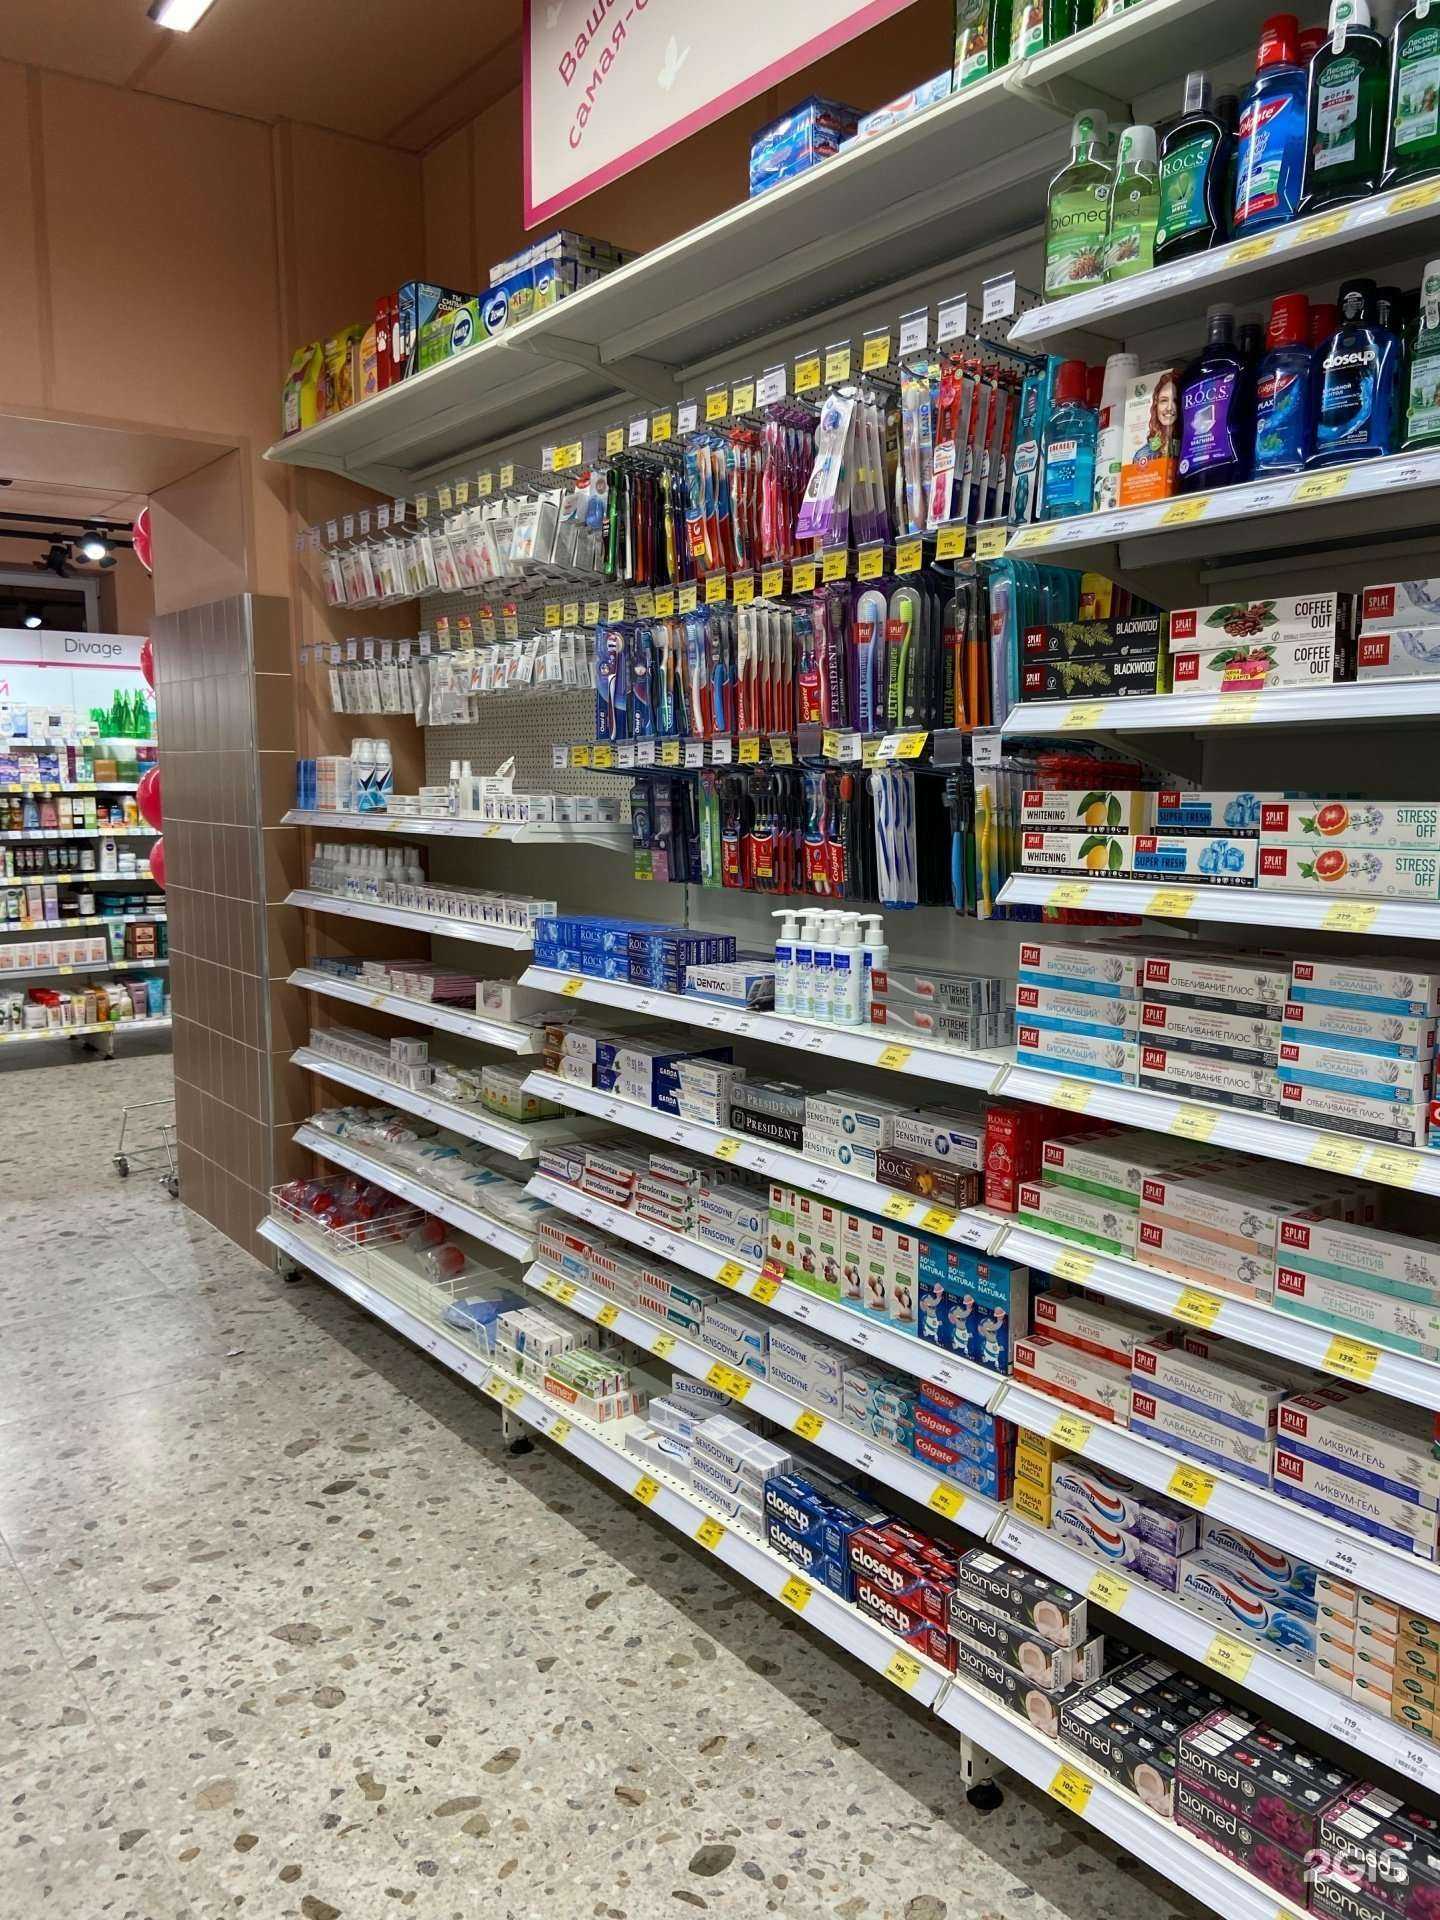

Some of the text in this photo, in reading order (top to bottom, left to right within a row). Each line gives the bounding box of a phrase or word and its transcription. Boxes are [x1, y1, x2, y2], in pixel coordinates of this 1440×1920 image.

[559, 0, 616, 87] Ваш
[1322, 350, 1376, 370] closeup
[1295, 600, 1333, 616] COFFEE
[1116, 620, 1158, 635] BLACKWOOD
[1311, 615, 1332, 629] OUT
[64, 638, 122, 658] Divage
[1294, 645, 1331, 661] COFFEE
[1114, 661, 1156, 676] BLACKWOOD
[1309, 660, 1330, 675] OUT
[829, 644, 839, 714] PRESIDENT
[887, 682, 899, 719] ULTRA
[944, 688, 953, 725] ULTRA
[1026, 810, 1066, 820] WHITENING
[1159, 811, 1212, 822] SUPER FRESH
[1396, 809, 1438, 824] STRESS
[1416, 823, 1437, 838] OFF
[1027, 852, 1067, 863] WHITENING
[1135, 855, 1186, 868] SUPER FRESH
[1395, 857, 1436, 873] STRESS
[1414, 872, 1436, 887] OFF
[1023, 947, 1040, 963] SPLAT
[1147, 964, 1168, 979] SPLAT
[939, 984, 969, 997] EXTREME
[1171, 976, 1254, 997] ОТБЕЛИВАНИЕ ПЛЮС
[948, 995, 969, 1008] WHITE
[1020, 990, 1038, 1006] SPLAT
[938, 1017, 969, 1032] EXTREME
[1144, 1008, 1164, 1024] SPLAT
[948, 1029, 969, 1043] WHITE
[1021, 1030, 1038, 1046] SPLAT
[1167, 1022, 1250, 1044] ОТБЕЛИВАНИЕ ПЛЮС
[1144, 1051, 1164, 1068] SPLAT
[1167, 1066, 1250, 1090] ОТБЕЛИВАНИЕ ПЛЮС
[1306, 1097, 1385, 1121] ОТБЕЛИВАНИЕ ПЛЮС
[746, 1115, 799, 1142] PRESIDENT
[806, 1112, 840, 1127] SENSITIVE
[803, 1140, 836, 1157] SENSITIVE
[896, 1129, 933, 1148] SENSITIVE
[539, 1155, 567, 1170] parodontax
[590, 1159, 618, 1176] parodontax
[650, 1159, 679, 1175] parodontax
[586, 1178, 615, 1196] parodontax
[638, 1182, 670, 1200] parodontax
[1145, 1184, 1163, 1199] SPLAT
[638, 1200, 670, 1220] parodontax
[701, 1199, 733, 1220] SENSODYNE
[540, 1223, 566, 1243] LACALUT
[701, 1226, 736, 1246] SENSODYNE
[1142, 1227, 1161, 1242] SPLAT
[1285, 1227, 1307, 1242] SPLAT
[539, 1243, 562, 1264] LACALUT
[591, 1253, 617, 1273] LACALUT
[1327, 1248, 1384, 1270] СЕНСИТИВ
[920, 1262, 946, 1279] NATURAL
[1281, 1273, 1302, 1288] SPLAT
[591, 1271, 616, 1292] LACALUT
[643, 1270, 671, 1293] LACALUT
[948, 1273, 976, 1290] NATURAL
[977, 1285, 1008, 1302] NATURAL
[639, 1294, 667, 1317] LACALUT
[1321, 1296, 1375, 1321] СЕНСИТИВ
[705, 1315, 739, 1337] SENSODYNE
[1077, 1323, 1100, 1339] АКТИВ
[702, 1333, 739, 1360] SENSODYNE
[771, 1338, 807, 1363] SENSODYNE
[1018, 1348, 1035, 1364] SPLAT
[1136, 1351, 1156, 1371] SPLAT
[771, 1366, 808, 1393] SENSODYNE
[1055, 1371, 1078, 1388] АКТИВ
[1162, 1372, 1224, 1402] ЛАВАНДАСЕПТ
[545, 1380, 574, 1403] elmex
[675, 1381, 725, 1401] SENSODYNE
[921, 1383, 955, 1408] Colgate
[1134, 1396, 1154, 1416] SPLAT
[915, 1411, 952, 1436] Colgate
[1284, 1411, 1304, 1426] SPLAT
[1162, 1417, 1224, 1449] ЛАВАНДАСЕПТ
[696, 1436, 734, 1467] SENSODYNE
[916, 1438, 953, 1464] Colgate
[1318, 1436, 1385, 1469] ЛИКВУМ-ГЕЛЬ
[693, 1457, 733, 1490] SENSODYNE
[1021, 1463, 1041, 1479] ПАСТА
[1280, 1457, 1300, 1473] SPLAT
[692, 1479, 732, 1512] SENSODYNE
[1055, 1475, 1095, 1503] Aquafresh
[1314, 1481, 1380, 1516] ЛИКВУМ-ГЕЛЬ
[766, 1487, 809, 1535] closeup
[1019, 1496, 1040, 1512] ПАСТА
[1055, 1510, 1095, 1537] Aquafresh
[770, 1523, 813, 1567] closeup
[1207, 1529, 1255, 1560] Aquafresh
[851, 1545, 904, 1589] closeup
[960, 1564, 1010, 1599] biomed
[1184, 1574, 1232, 1605] Aquafresh
[859, 1582, 910, 1632] closeup
[951, 1601, 996, 1638] biomed
[959, 1647, 1004, 1685] biomed
[1060, 1710, 1110, 1756] biomed
[1179, 1738, 1239, 1789] biomed
[1178, 1781, 1237, 1836] biomed
[1321, 1817, 1391, 1873] biomed
[1314, 1868, 1385, 1920] biomed
